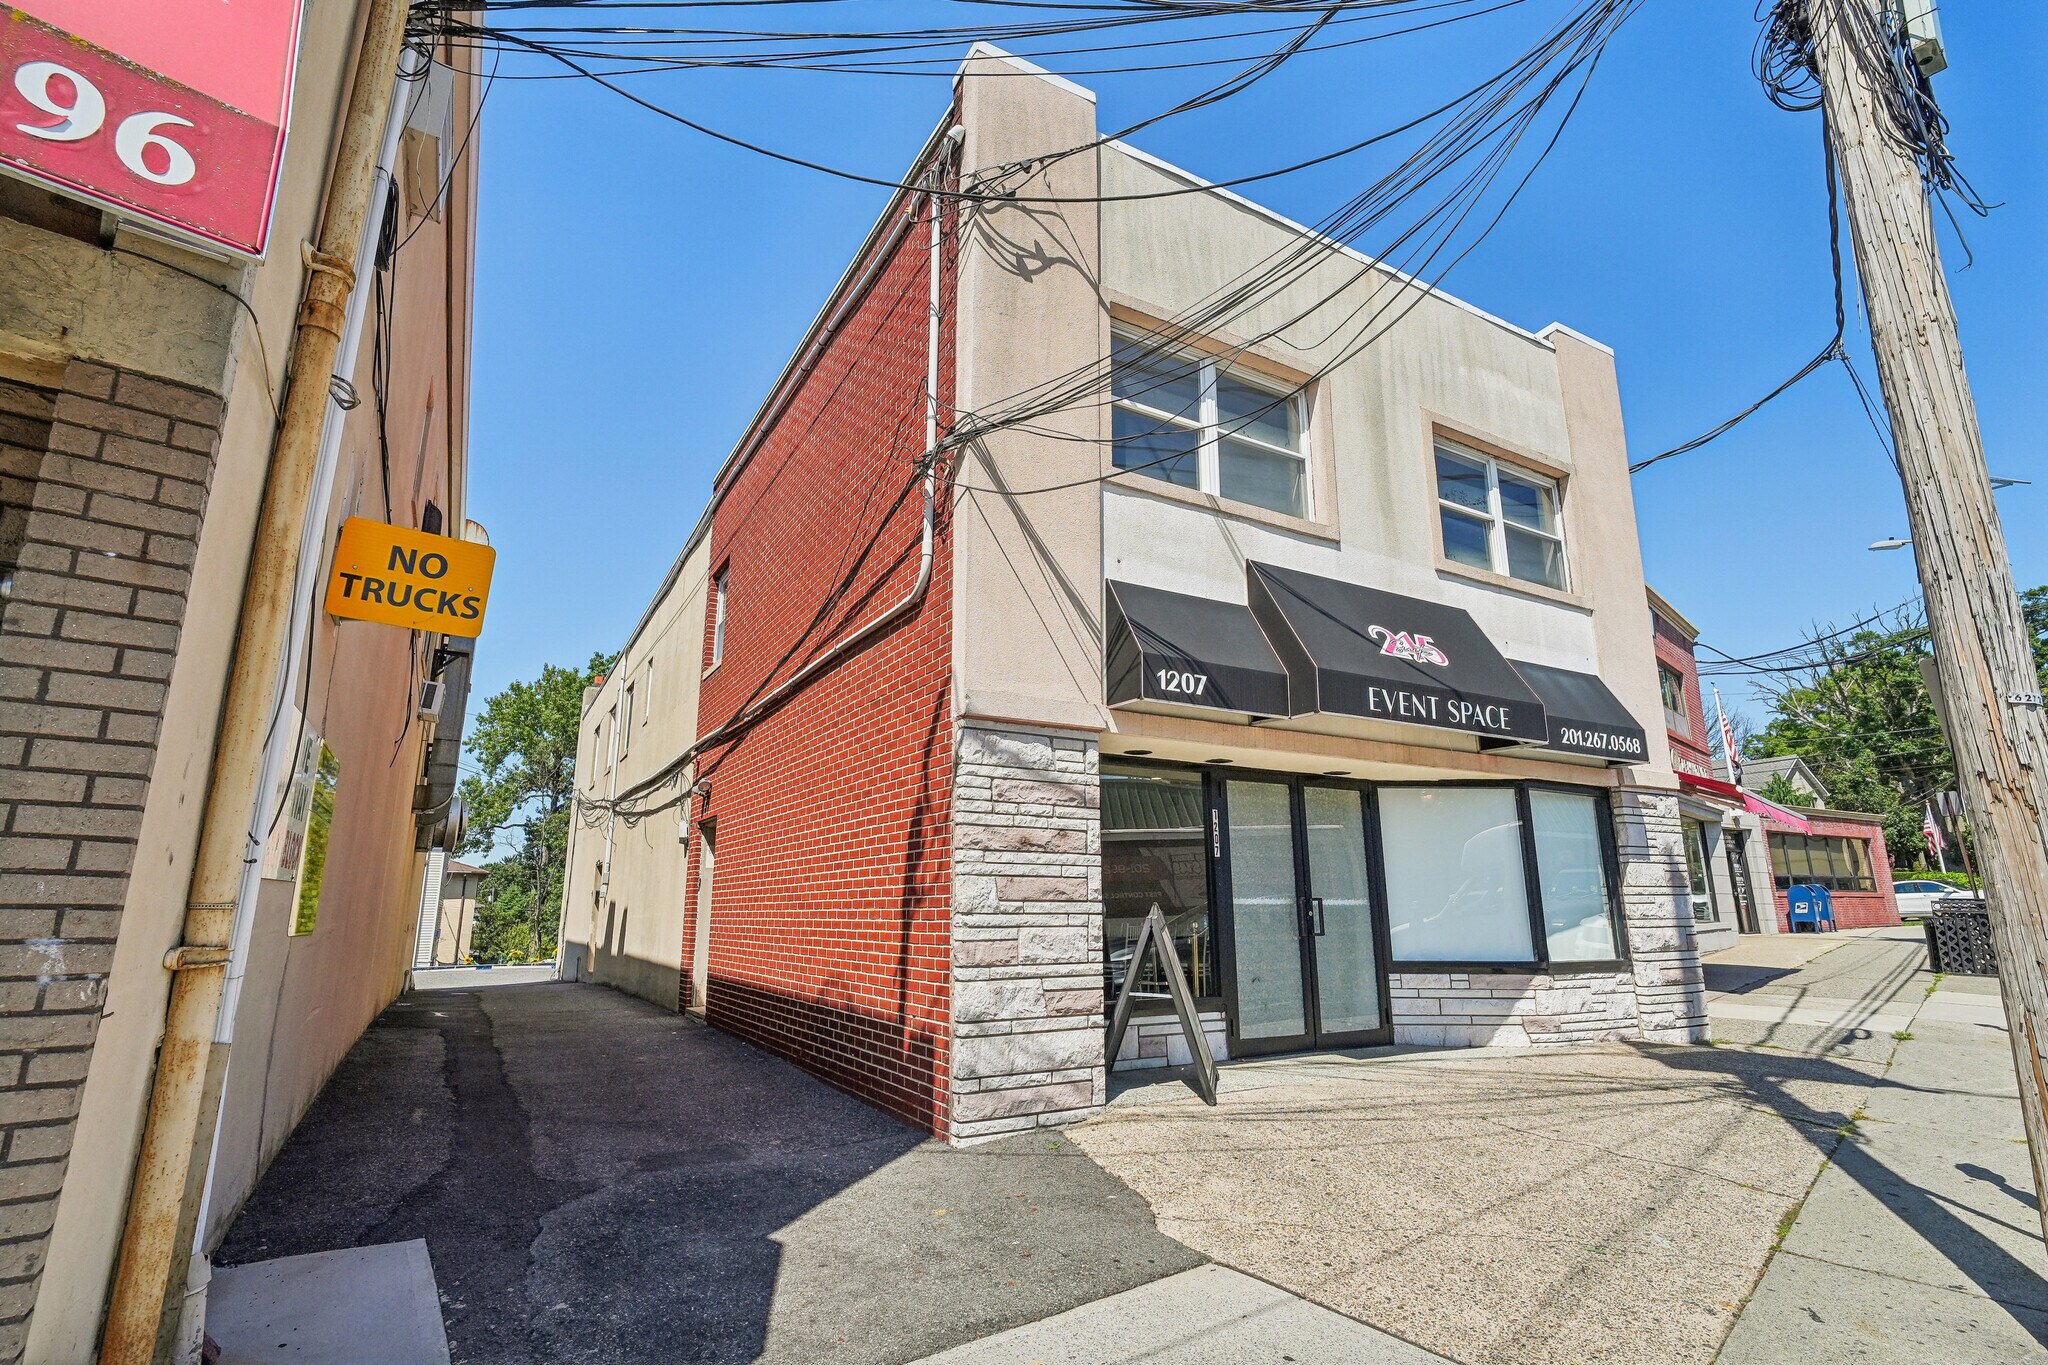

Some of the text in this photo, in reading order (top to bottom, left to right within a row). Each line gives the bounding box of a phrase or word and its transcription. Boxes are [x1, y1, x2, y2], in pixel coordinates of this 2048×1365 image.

[14, 61, 196, 186] 96
[387, 545, 448, 579] NO
[339, 572, 481, 619] TRUCKS
[1157, 669, 1208, 696] 1207
[1368, 686, 1511, 730] EVENT SPACE
[1560, 727, 1641, 754] 201.267.0568
